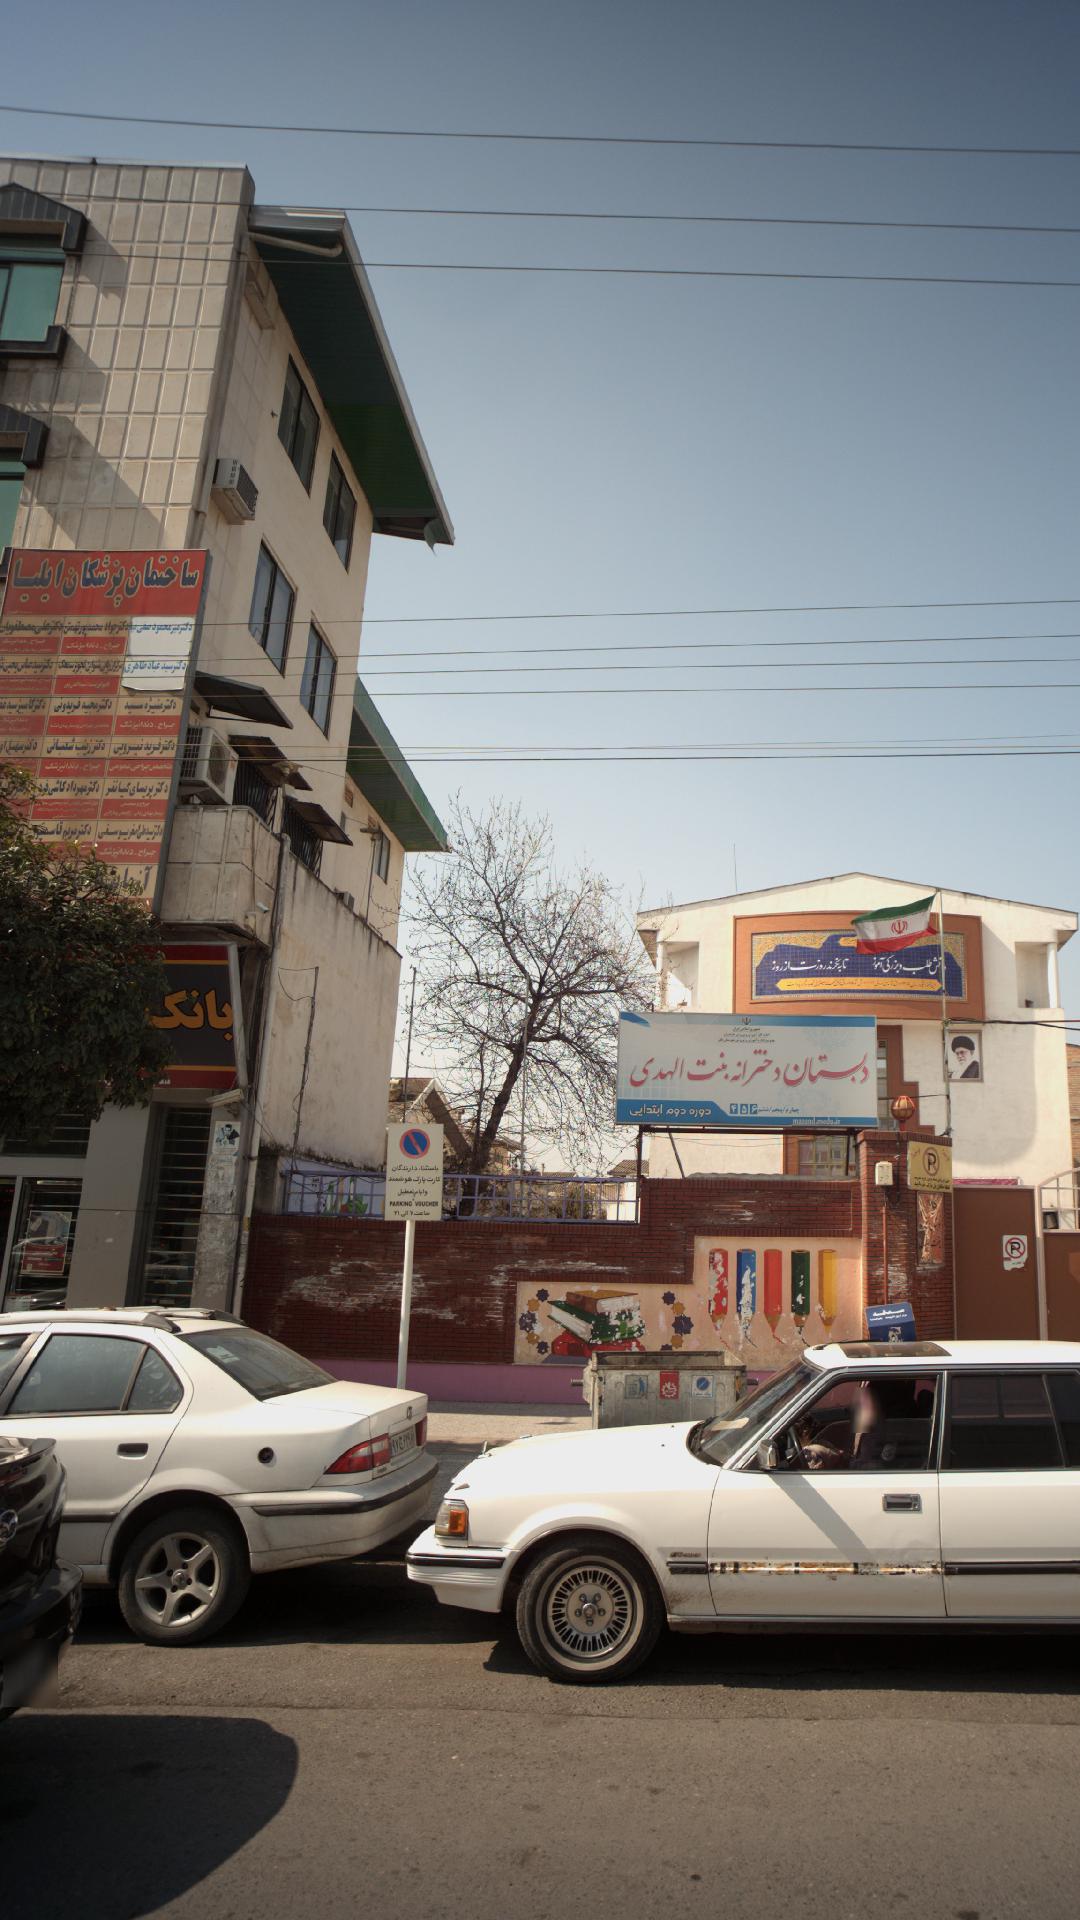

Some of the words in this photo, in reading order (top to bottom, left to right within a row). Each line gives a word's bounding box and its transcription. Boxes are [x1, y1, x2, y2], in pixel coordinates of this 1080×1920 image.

[12, 558, 64, 602] ایلیا
[62, 555, 124, 606] پزشکان
[124, 556, 199, 598] ساختمان
[162, 662, 172, 674] سید
[171, 660, 187, 674] دکتر
[96, 698, 112, 713] دکتر
[162, 698, 176, 712] دکتر
[91, 739, 106, 754] دکتر
[160, 739, 175, 754] دکتر
[86, 780, 100, 796] دکتر
[152, 780, 168, 797] دکتر
[75, 823, 92, 840] دکتر
[152, 824, 162, 840] دکتر
[902, 959, 933, 974] طلب
[149, 990, 234, 1041] بانک
[629, 1056, 686, 1088] الهدی
[687, 1052, 730, 1082] بنت
[730, 1049, 781, 1087] دخترانه
[783, 1052, 870, 1087] دبستان
[629, 1103, 663, 1117] ابتدایی
[666, 1107, 687, 1118] دوم
[689, 1107, 712, 1118] دوره
[392, 1164, 418, 1172] دارندگان
[412, 1176, 428, 1184] پارک
[428, 1176, 441, 1184] کارت
